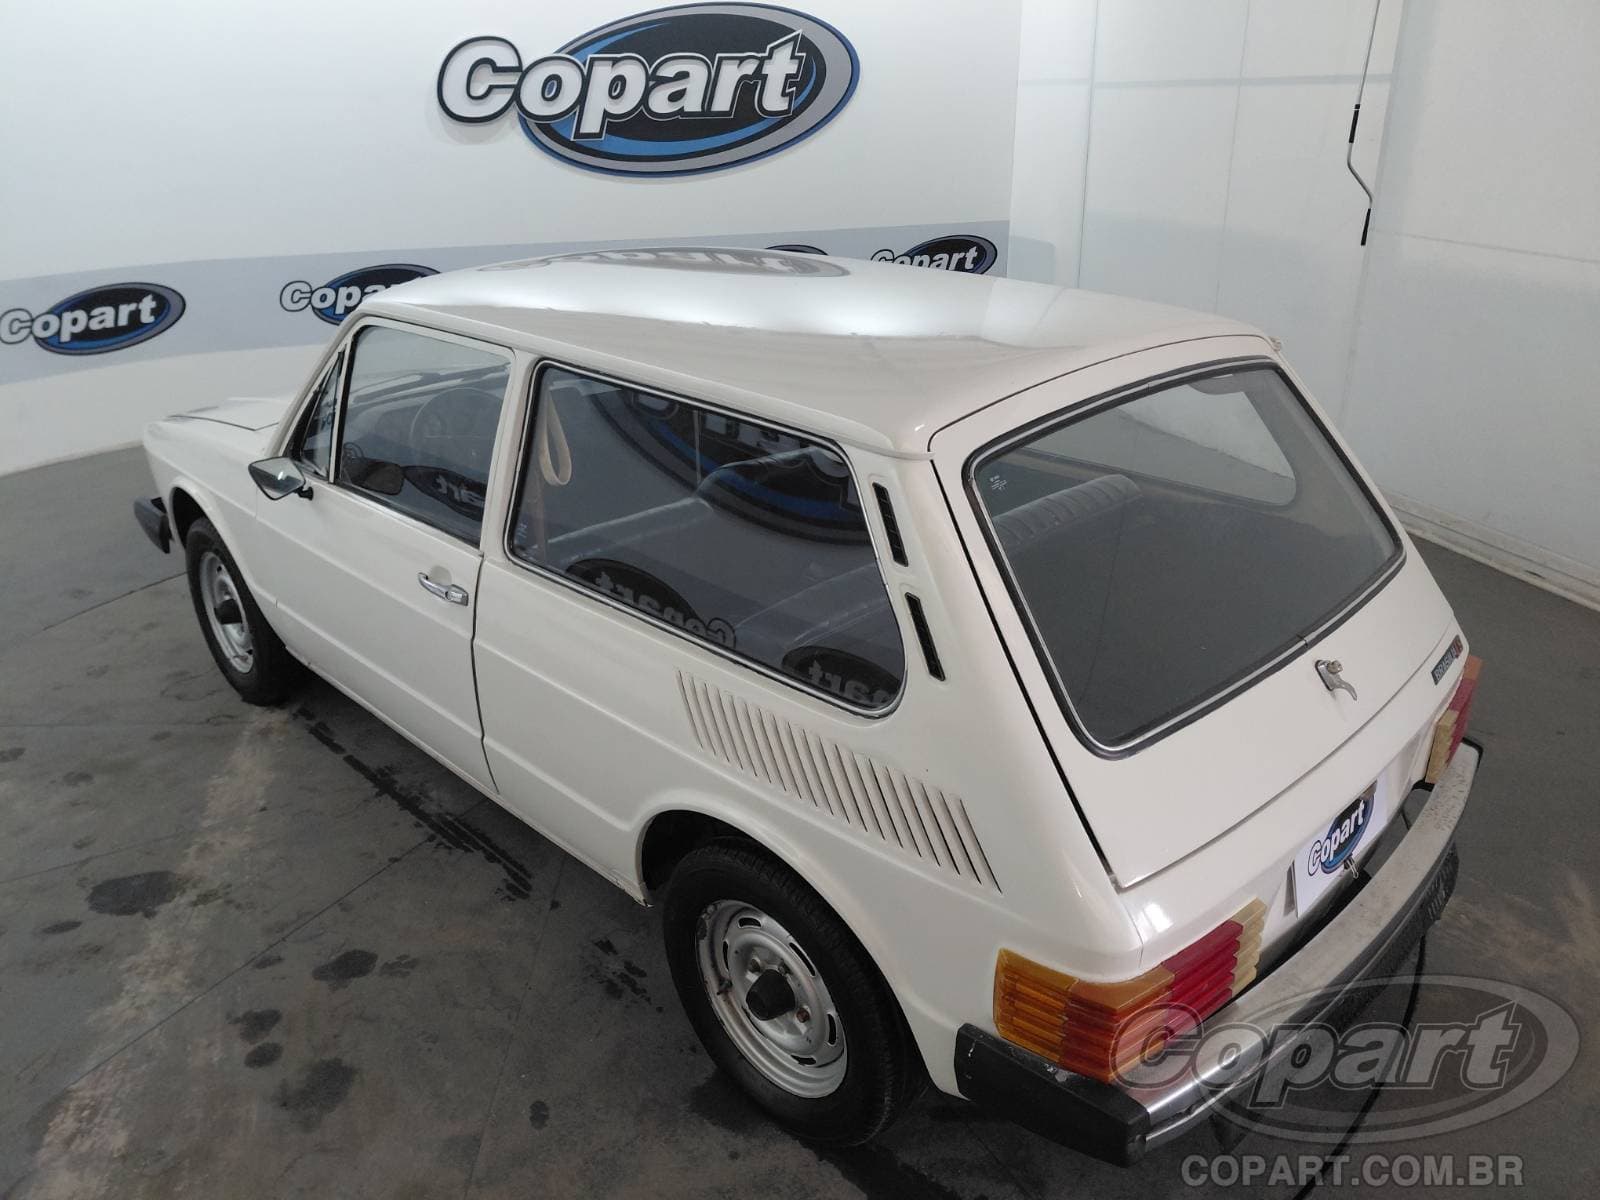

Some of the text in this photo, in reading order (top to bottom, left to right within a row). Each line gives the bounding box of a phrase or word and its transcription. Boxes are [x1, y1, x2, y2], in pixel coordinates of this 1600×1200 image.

[438, 31, 804, 140] Copart
[0, 294, 157, 345] Copart
[1308, 800, 1365, 876] Copart
